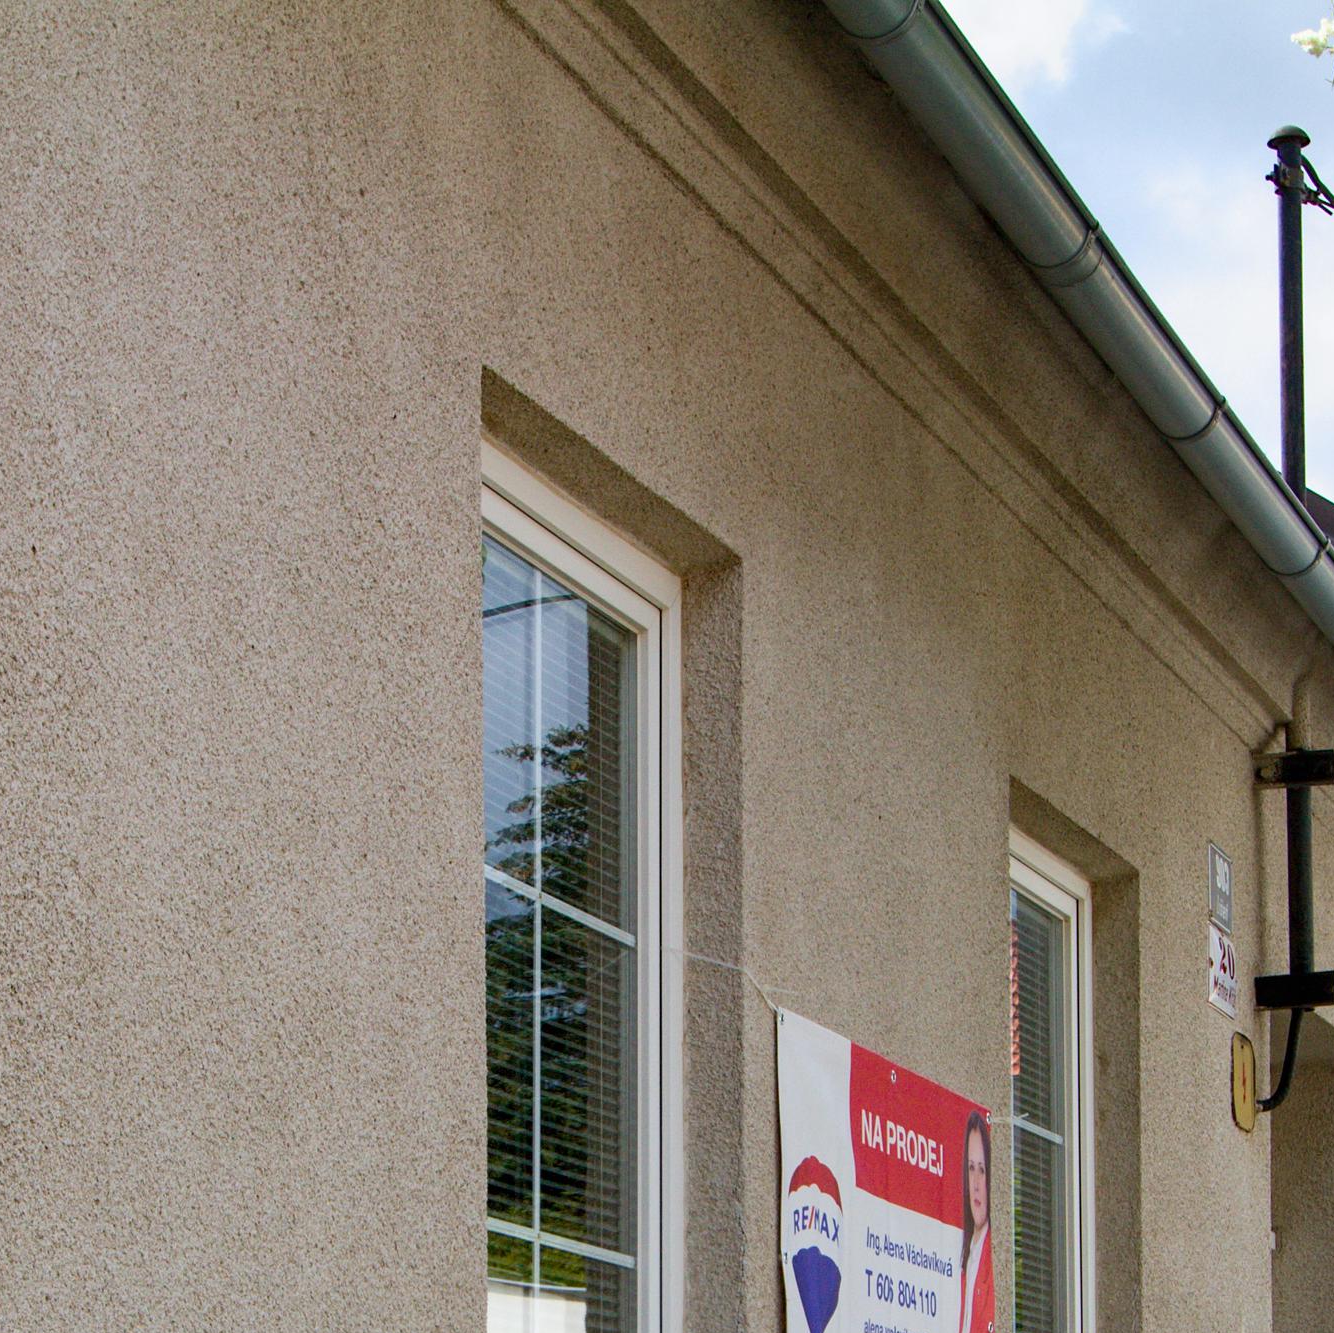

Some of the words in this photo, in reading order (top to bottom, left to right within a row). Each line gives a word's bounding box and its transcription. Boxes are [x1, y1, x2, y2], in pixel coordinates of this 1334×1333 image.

[861, 1109, 884, 1153] NA
[885, 1121, 944, 1178] PRODEJ
[866, 1226, 882, 1256] Ing.
[865, 1268, 873, 1297] T
[898, 1280, 916, 1310] 804
[919, 1288, 937, 1317] 110
